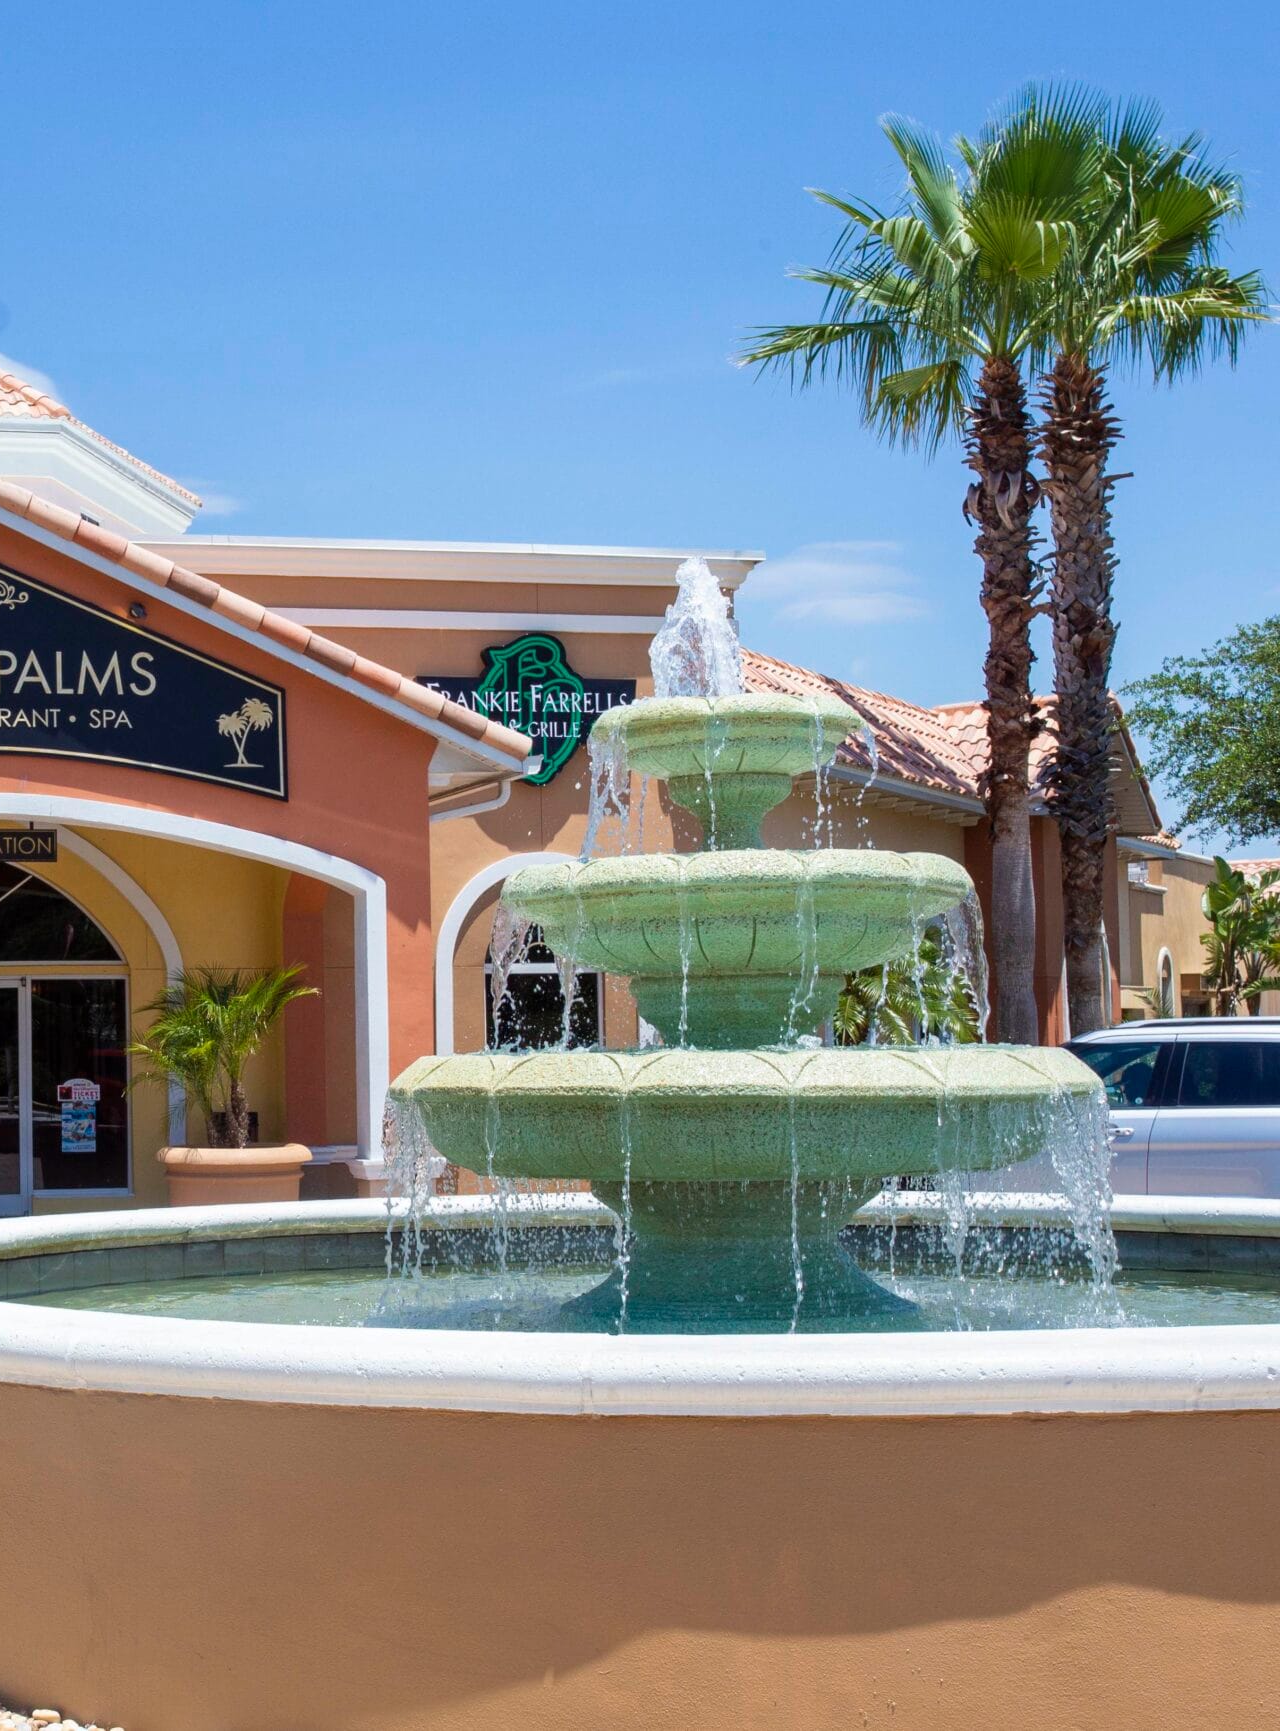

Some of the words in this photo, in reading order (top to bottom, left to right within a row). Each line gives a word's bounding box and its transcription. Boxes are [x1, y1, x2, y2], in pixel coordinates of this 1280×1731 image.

[426, 682, 522, 712] ANKIE
[89, 709, 133, 729] SPA
[527, 721, 581, 738] GRILLE
